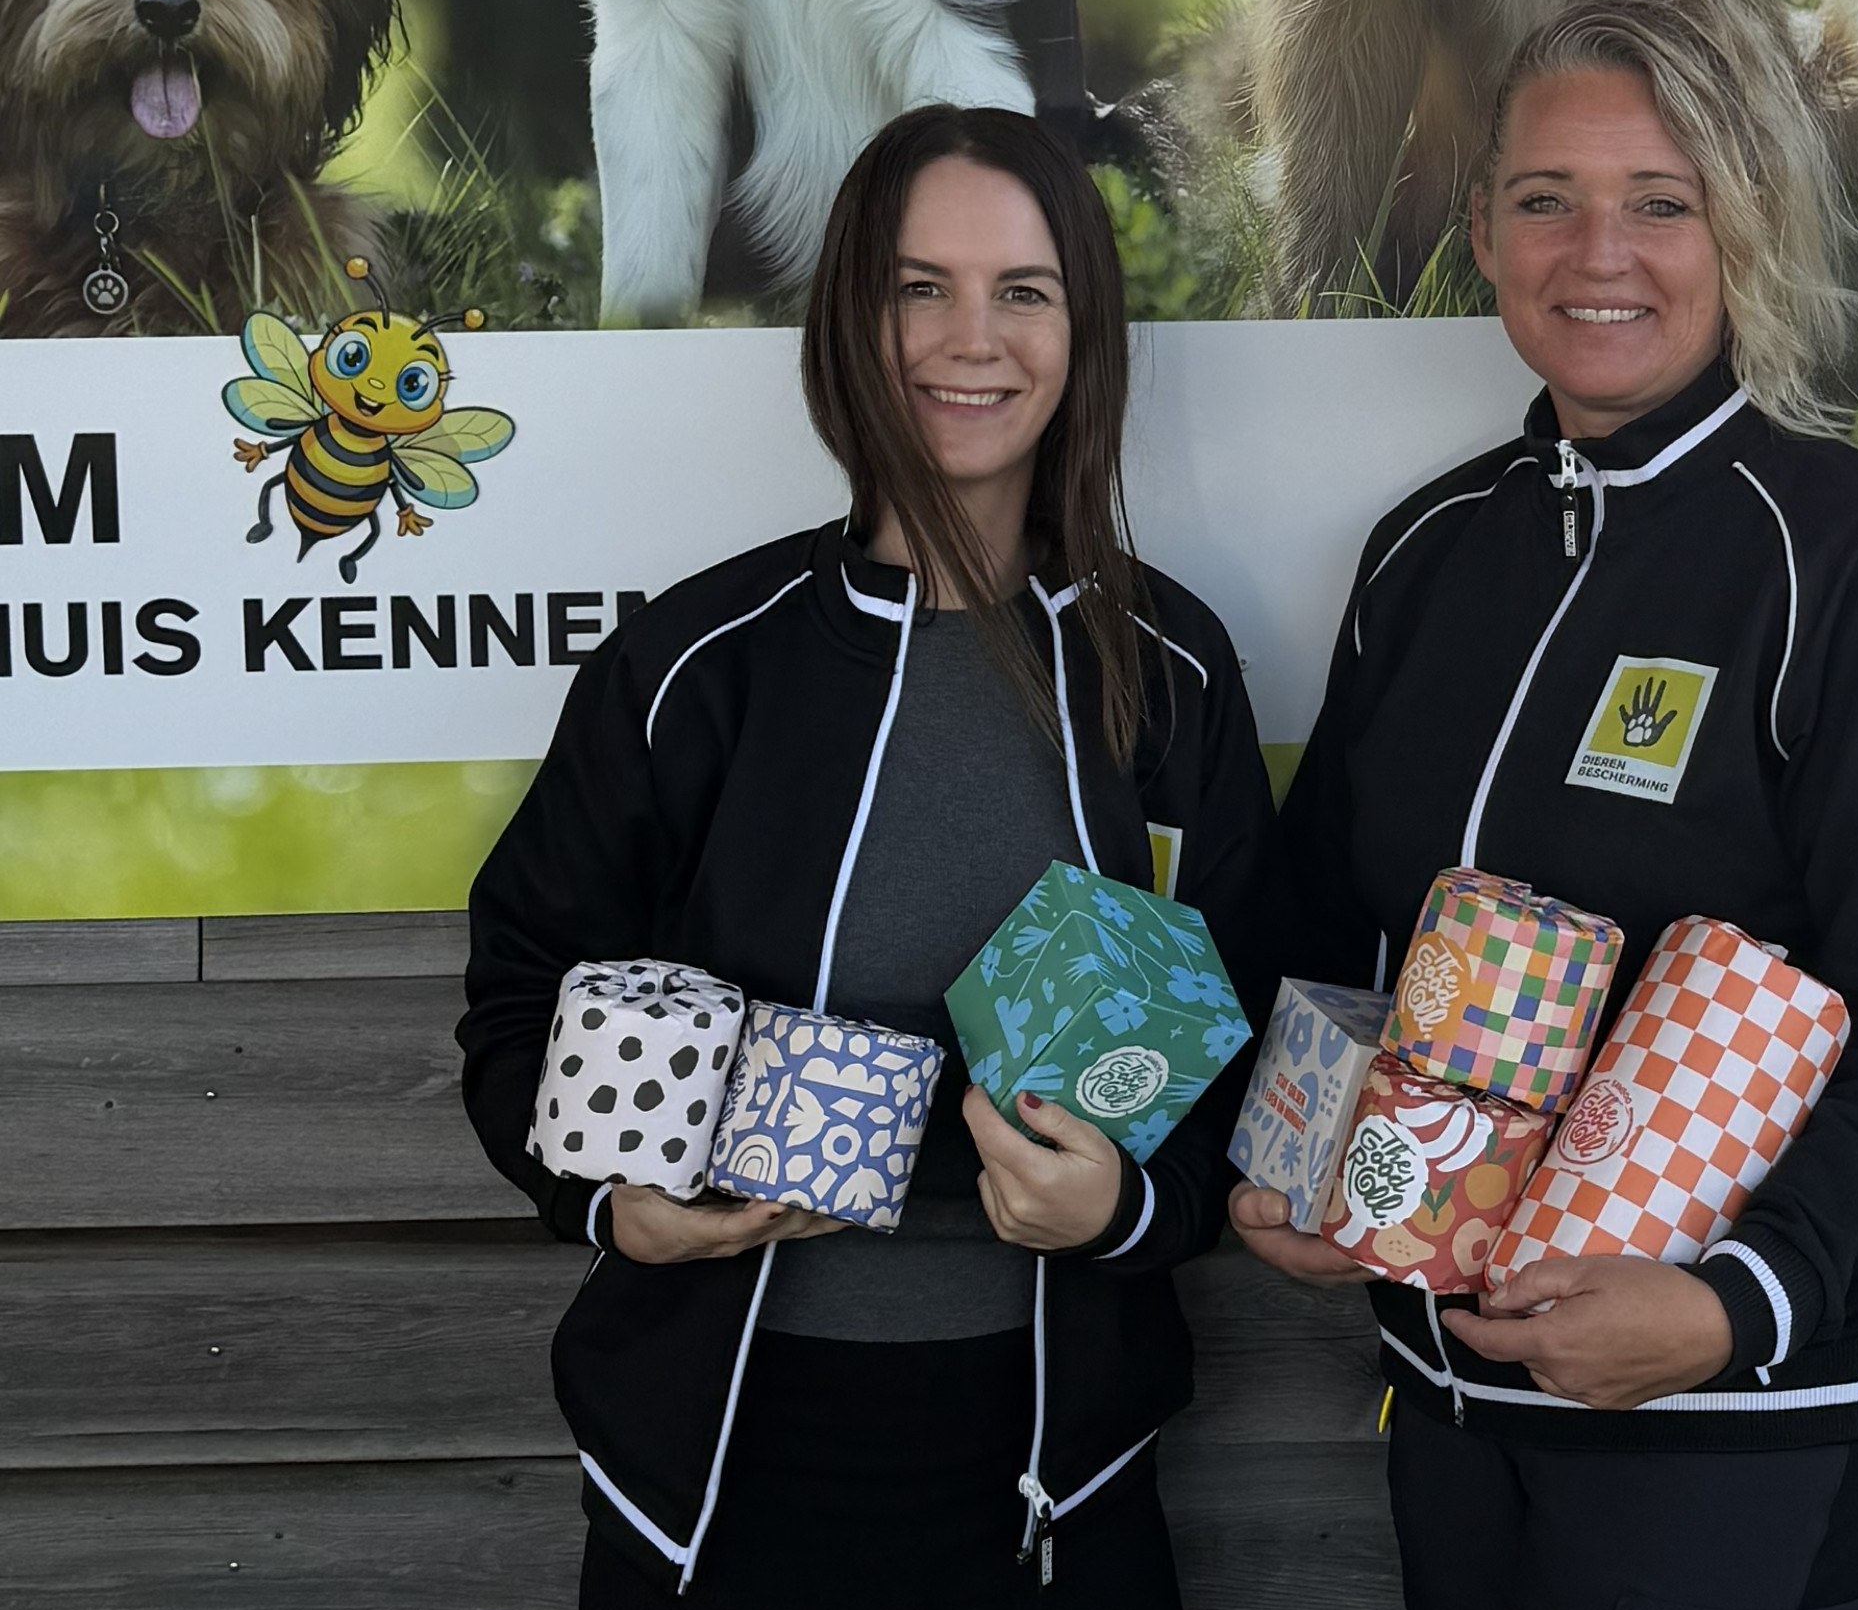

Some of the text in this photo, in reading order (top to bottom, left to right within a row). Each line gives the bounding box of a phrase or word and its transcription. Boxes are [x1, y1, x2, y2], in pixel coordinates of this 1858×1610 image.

[1577, 766, 1669, 793] BESCHERMING
[1582, 755, 1627, 771] DIEREN
[1416, 943, 1461, 1008] Good
[1434, 937, 1465, 989] The
[1581, 1093, 1619, 1136] Good
[1597, 1086, 1624, 1120] The
[1361, 1127, 1415, 1192] Good
[1381, 1122, 1417, 1173] The
